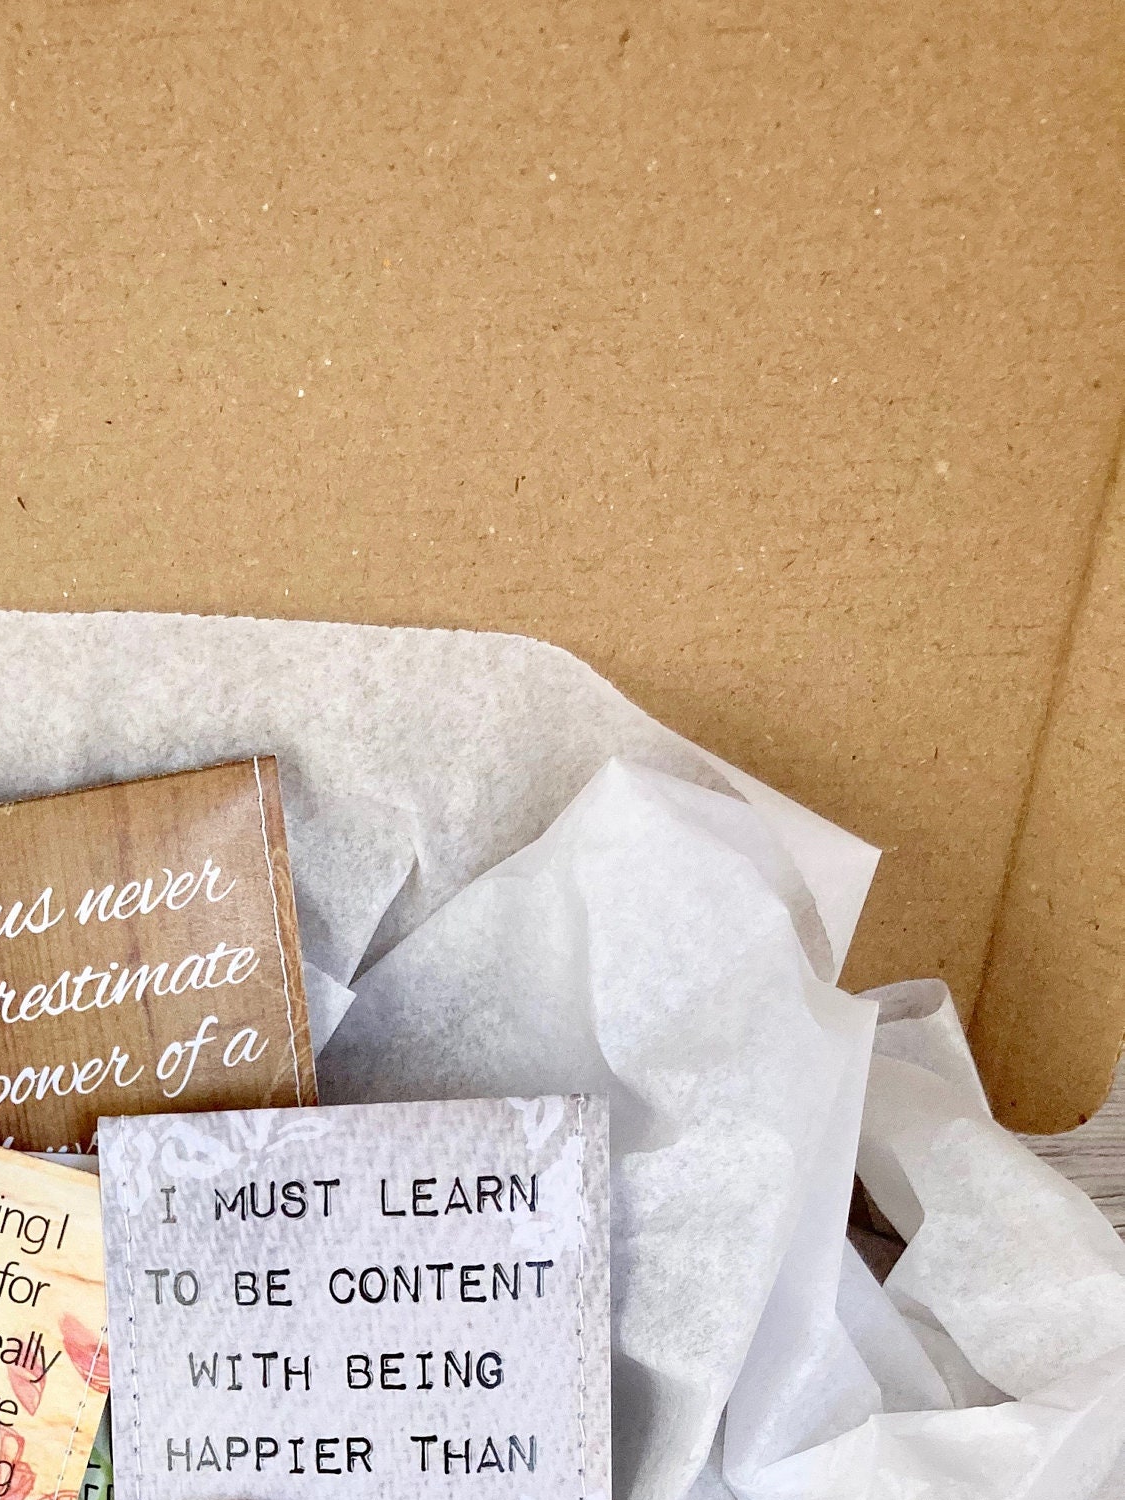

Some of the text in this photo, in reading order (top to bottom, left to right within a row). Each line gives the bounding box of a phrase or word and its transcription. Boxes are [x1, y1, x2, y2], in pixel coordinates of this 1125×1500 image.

[74, 860, 237, 924] never
[156, 1016, 216, 1098] of
[224, 1025, 270, 1068] a
[161, 1173, 540, 1224] I MUST LEARN
[56, 1214, 69, 1249] I
[145, 1260, 555, 1306] TO BE CONTENT
[188, 1351, 506, 1391] WITH BEING
[166, 1433, 537, 1475] HAPPIER THAN
